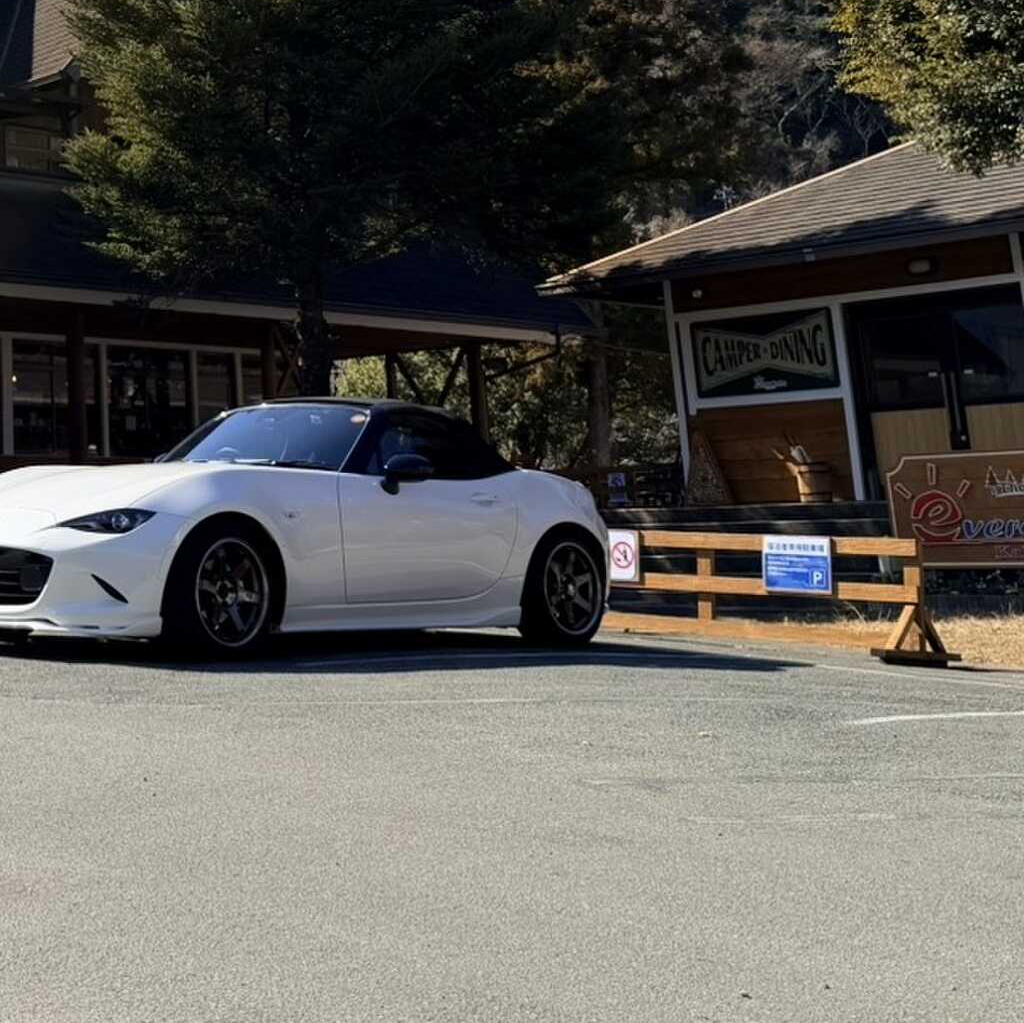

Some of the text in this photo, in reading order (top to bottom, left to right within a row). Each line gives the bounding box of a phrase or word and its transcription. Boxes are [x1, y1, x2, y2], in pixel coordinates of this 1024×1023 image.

[701, 323, 827, 377] CAMPER DINING
[812, 569, 824, 587] P
